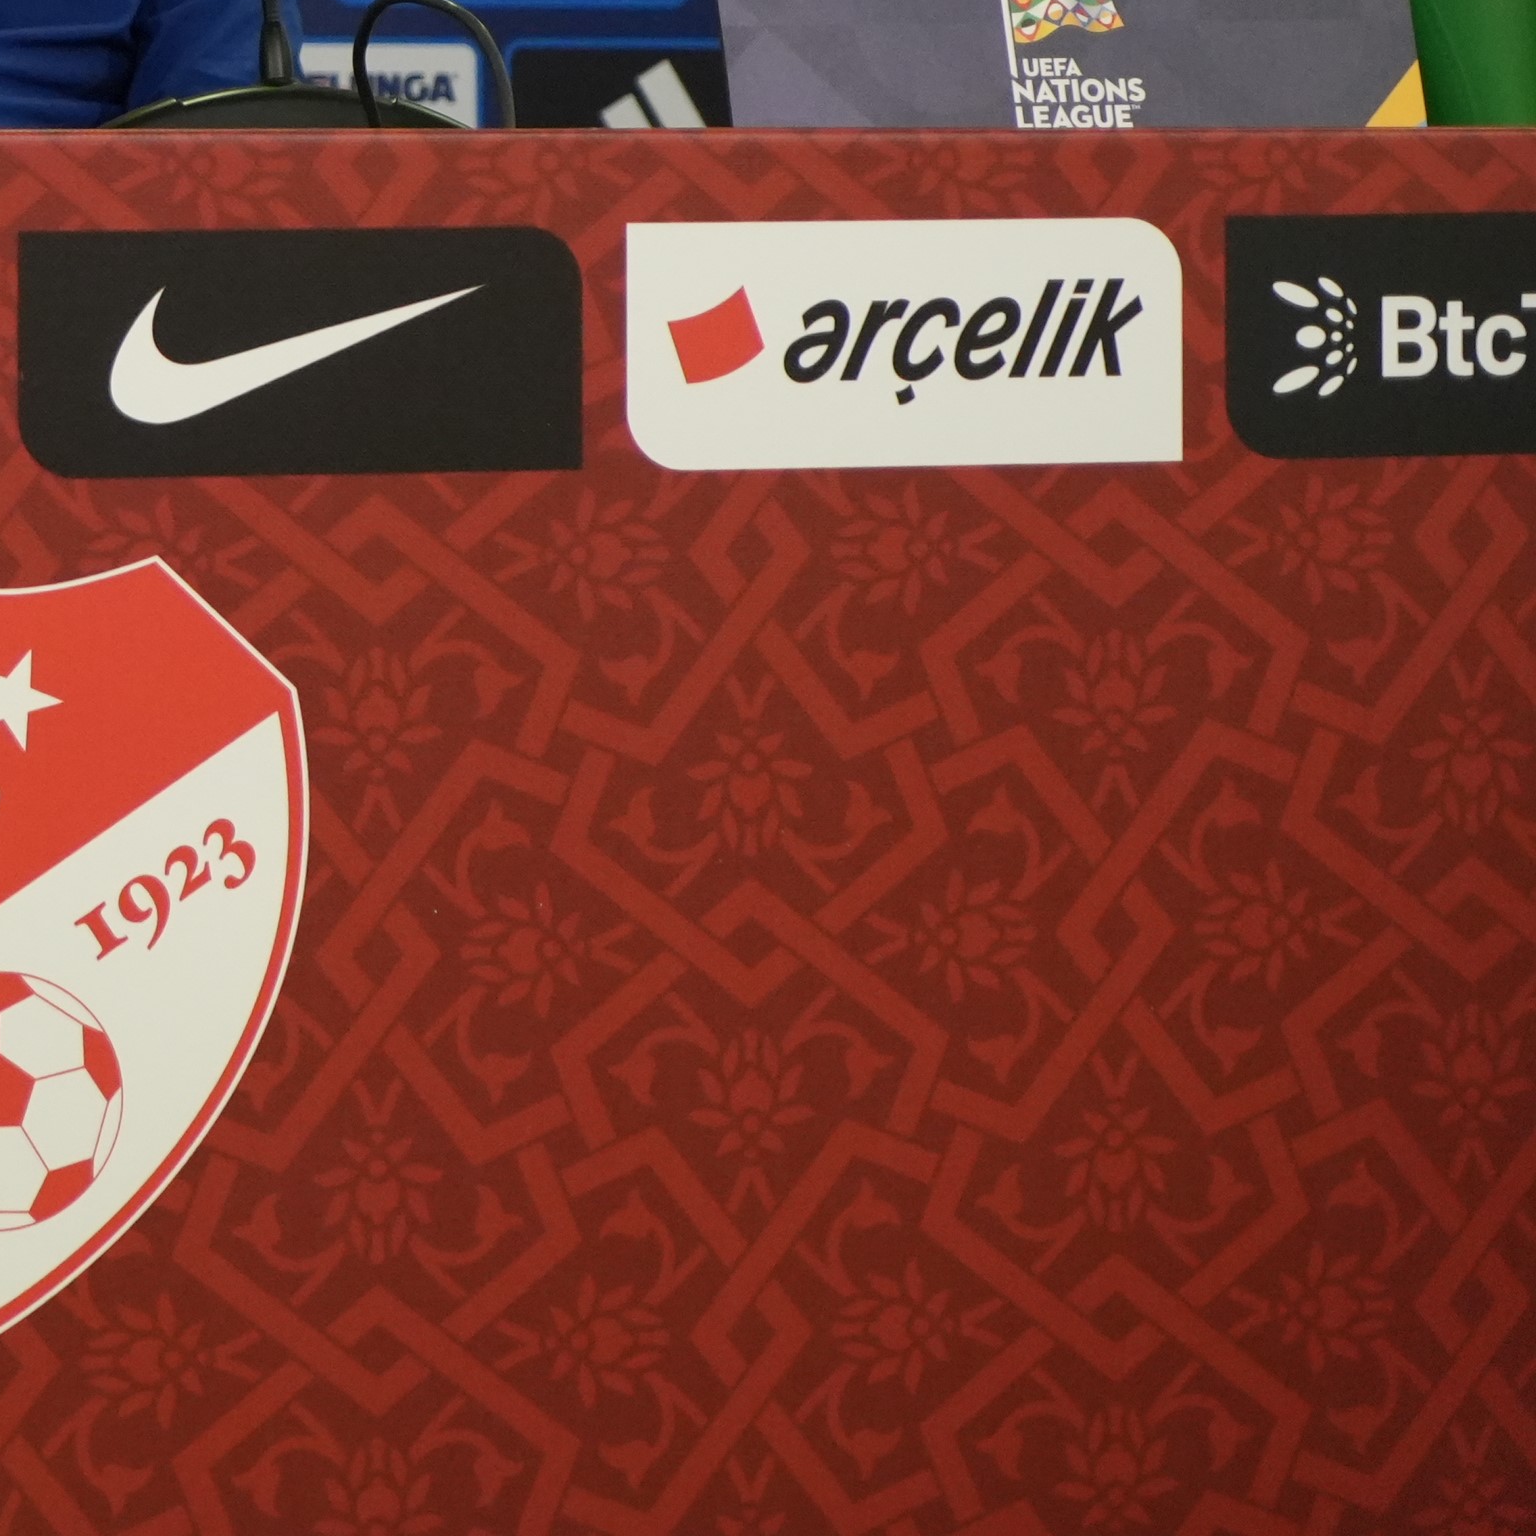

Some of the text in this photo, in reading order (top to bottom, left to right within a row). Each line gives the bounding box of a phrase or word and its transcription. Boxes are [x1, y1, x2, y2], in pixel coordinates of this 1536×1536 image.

[1012, 78, 1146, 103] NATIONS
[1023, 58, 1082, 77] UEFA
[783, 278, 1143, 406] arçelik
[72, 817, 256, 961] 1923
